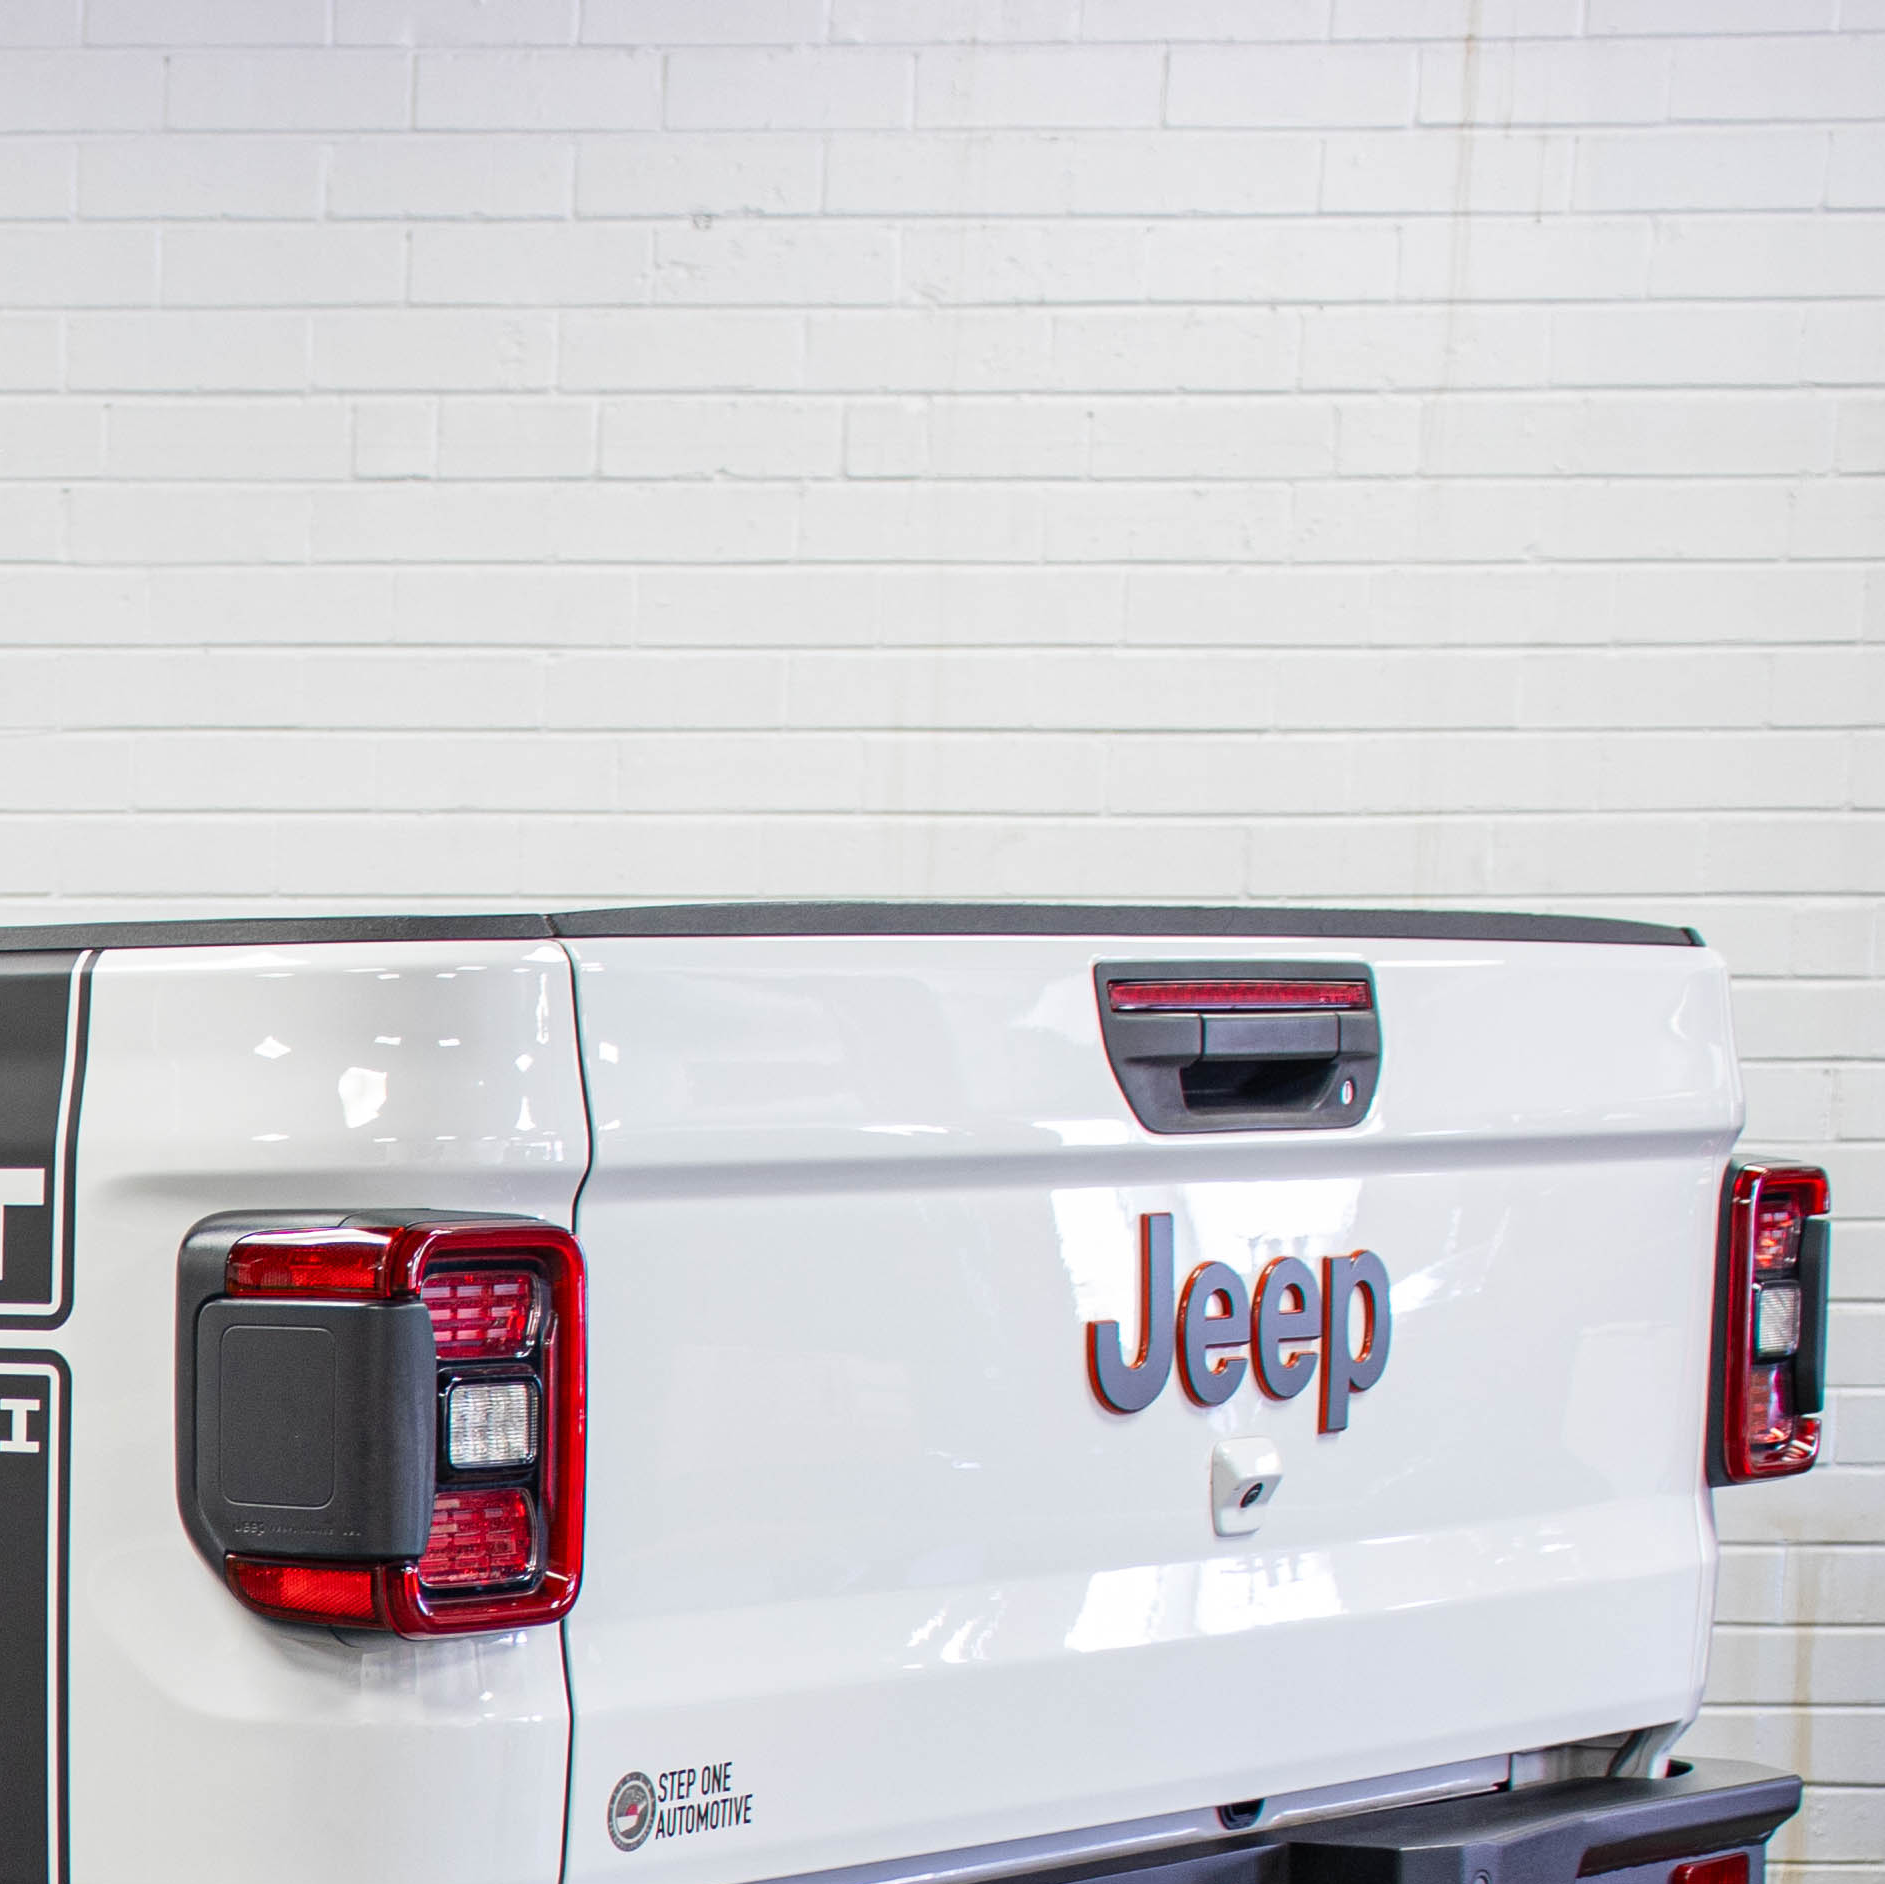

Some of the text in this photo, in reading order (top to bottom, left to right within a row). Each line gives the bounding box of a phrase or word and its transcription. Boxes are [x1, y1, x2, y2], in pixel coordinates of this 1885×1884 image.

[1085, 1211, 1392, 1435] Jeep
[657, 1761, 733, 1803] STEP ONE
[655, 1793, 753, 1840] AUTOMOTIVE
